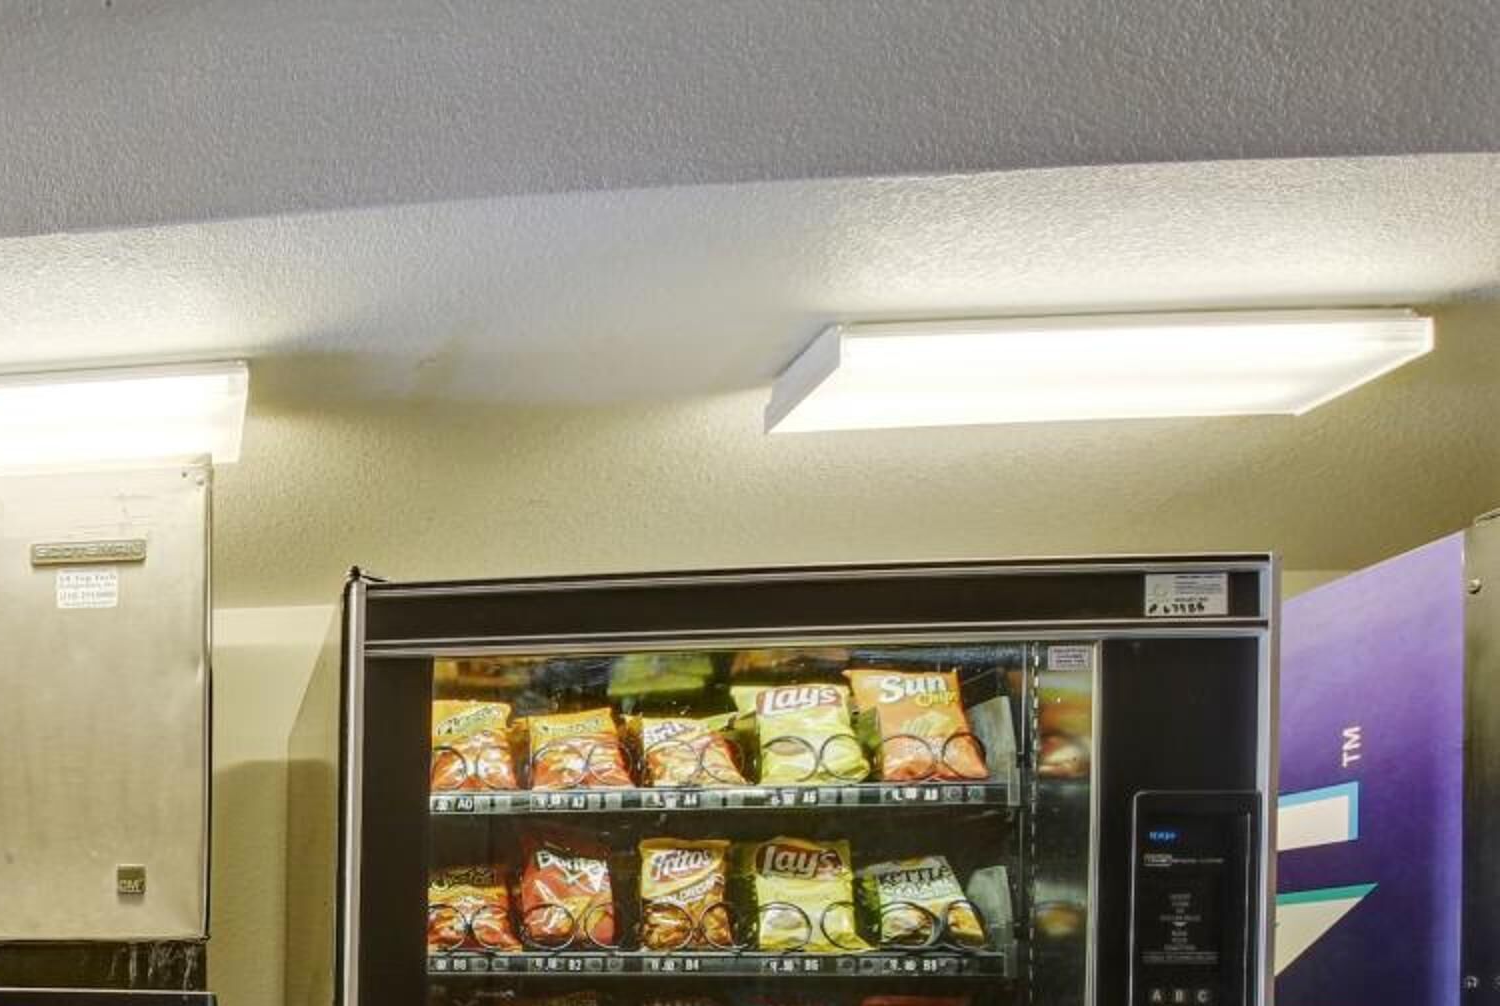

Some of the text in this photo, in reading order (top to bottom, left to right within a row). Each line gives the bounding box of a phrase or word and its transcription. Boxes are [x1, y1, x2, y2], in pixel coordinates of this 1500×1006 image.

[878, 675, 948, 704] Sun
[1343, 726, 1361, 767] TM
[1152, 989, 1161, 1000] A
[1197, 989, 1207, 1001] C
